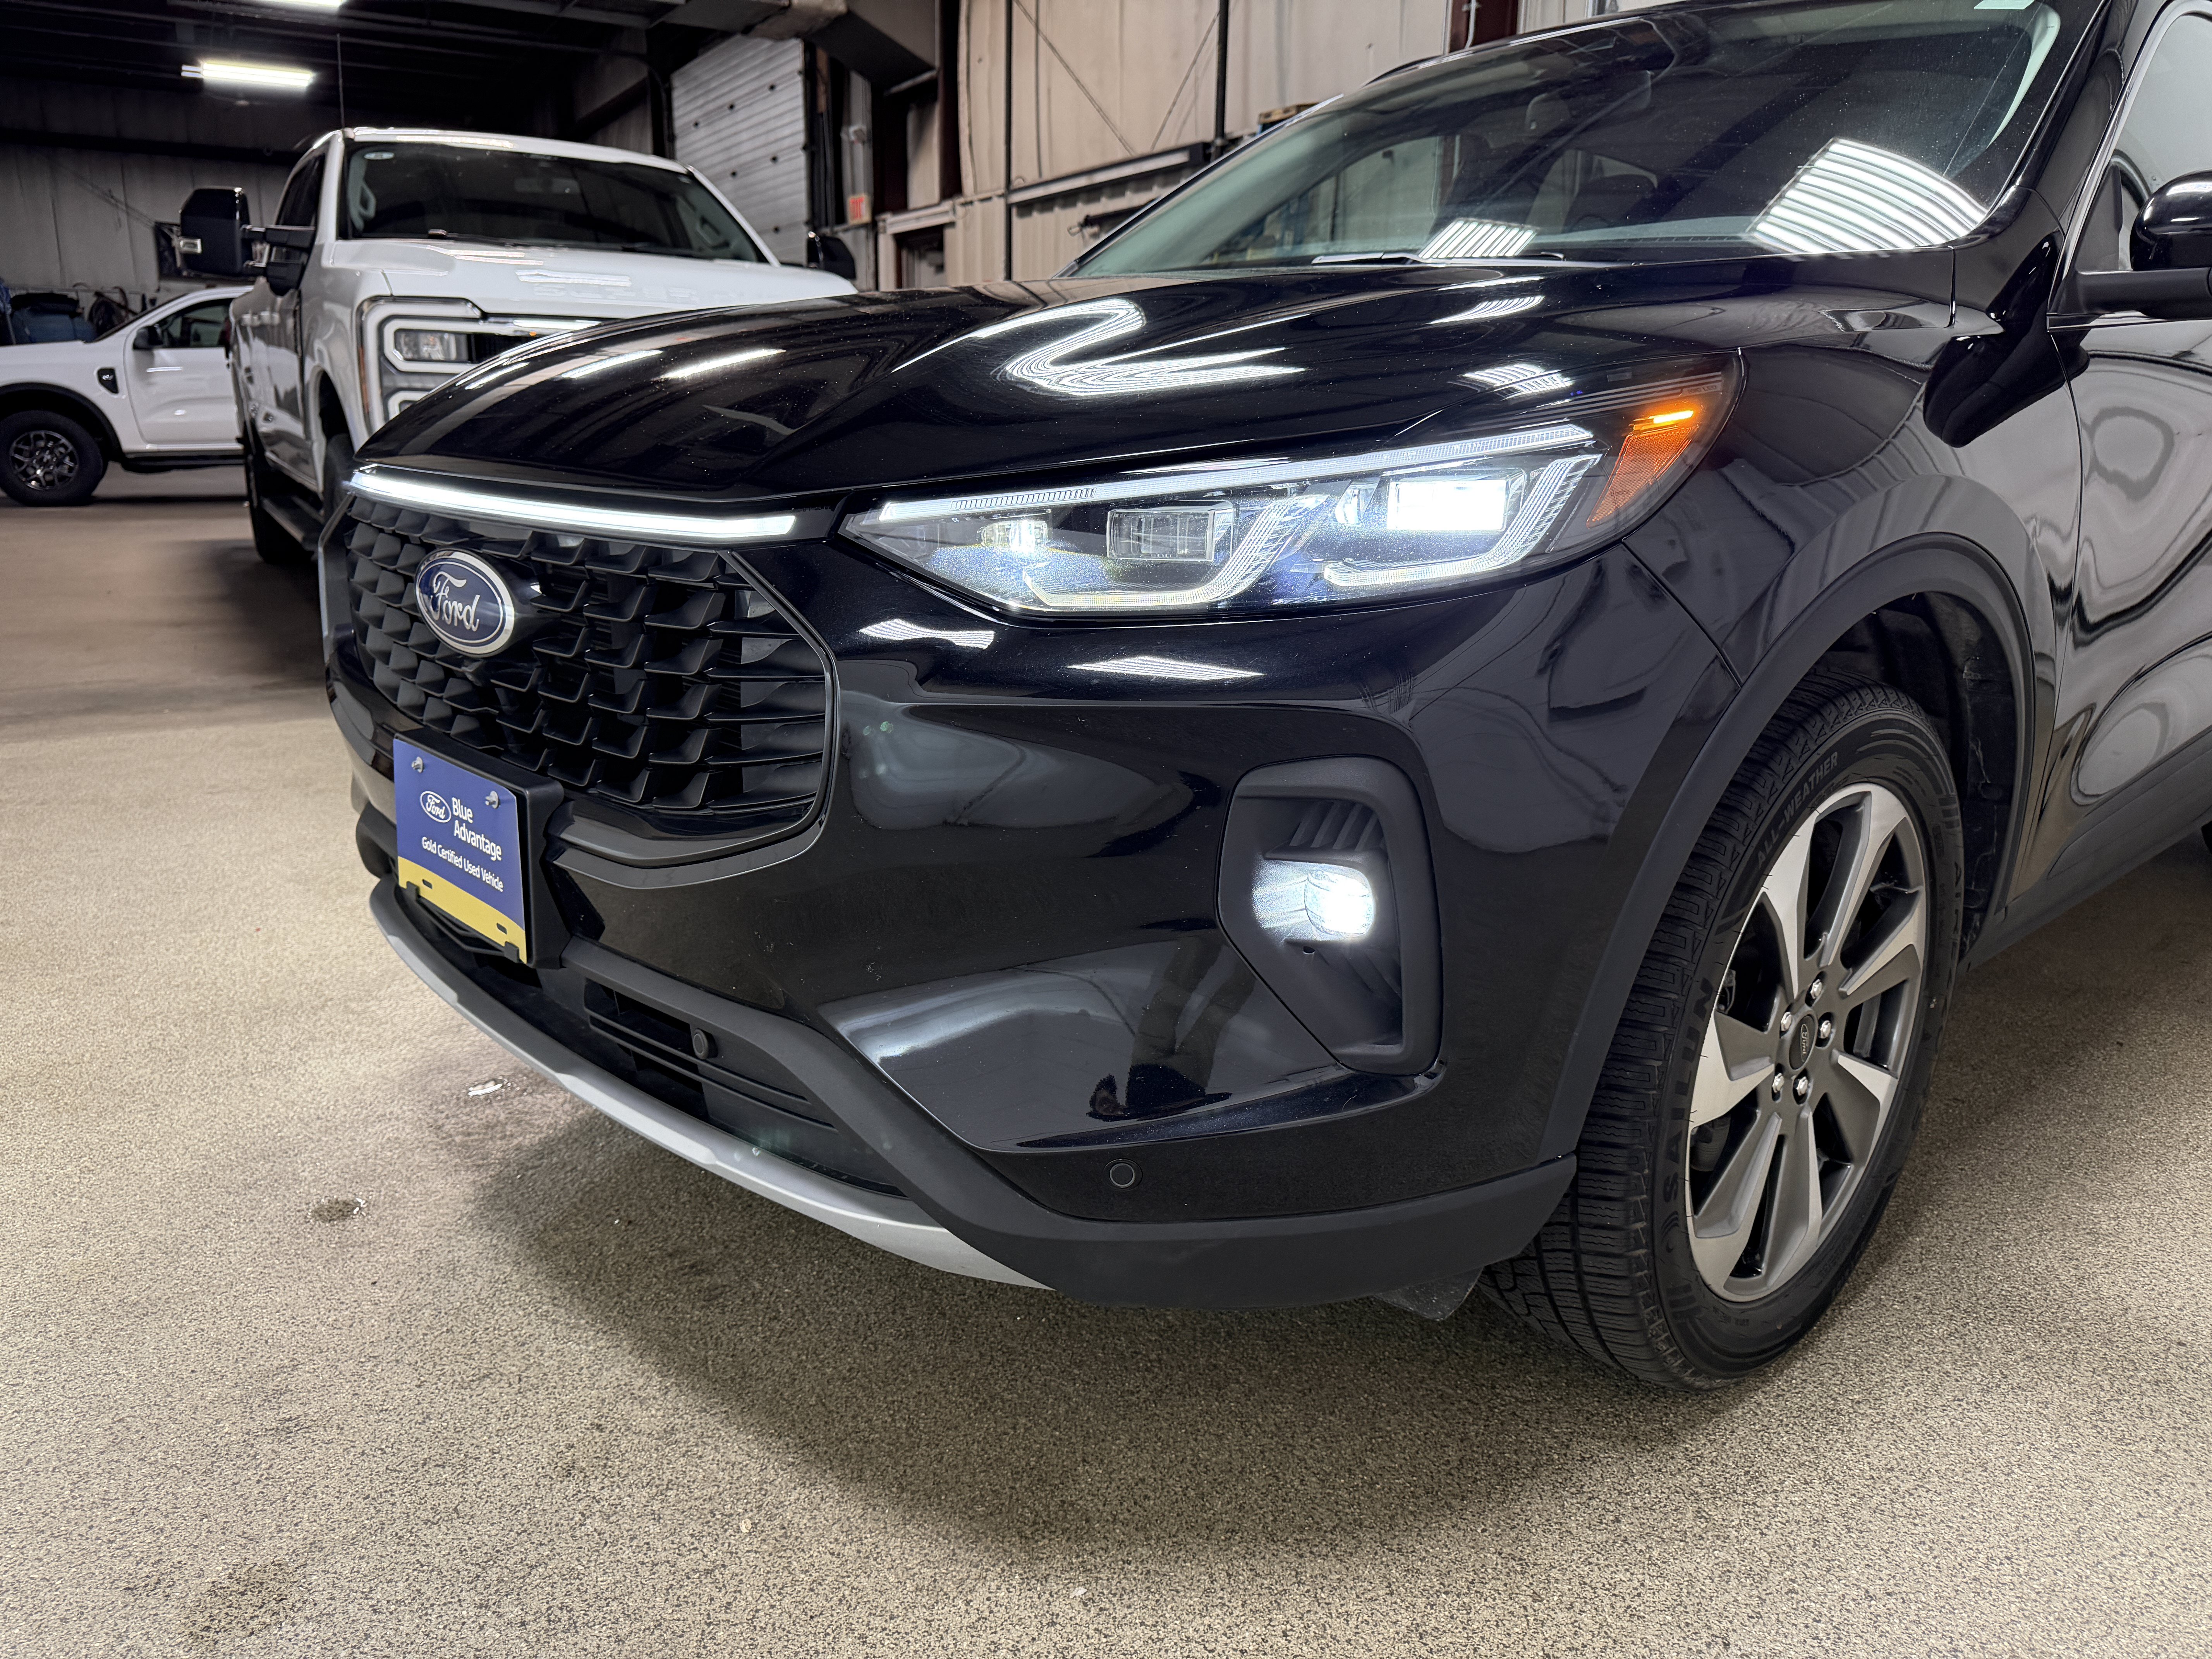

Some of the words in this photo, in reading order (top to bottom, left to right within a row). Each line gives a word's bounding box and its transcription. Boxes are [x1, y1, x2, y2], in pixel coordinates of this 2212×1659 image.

[430, 571, 481, 632] Ford
[426, 794, 446, 819] Ford
[452, 797, 473, 823] Blue
[1757, 751, 1838, 869] ALL-WEATHER
[421, 836, 437, 854] Gold
[438, 844, 463, 869] Certified
[464, 858, 480, 878] Used
[481, 867, 503, 892] Vehicle
[454, 819, 502, 861] Advantage
